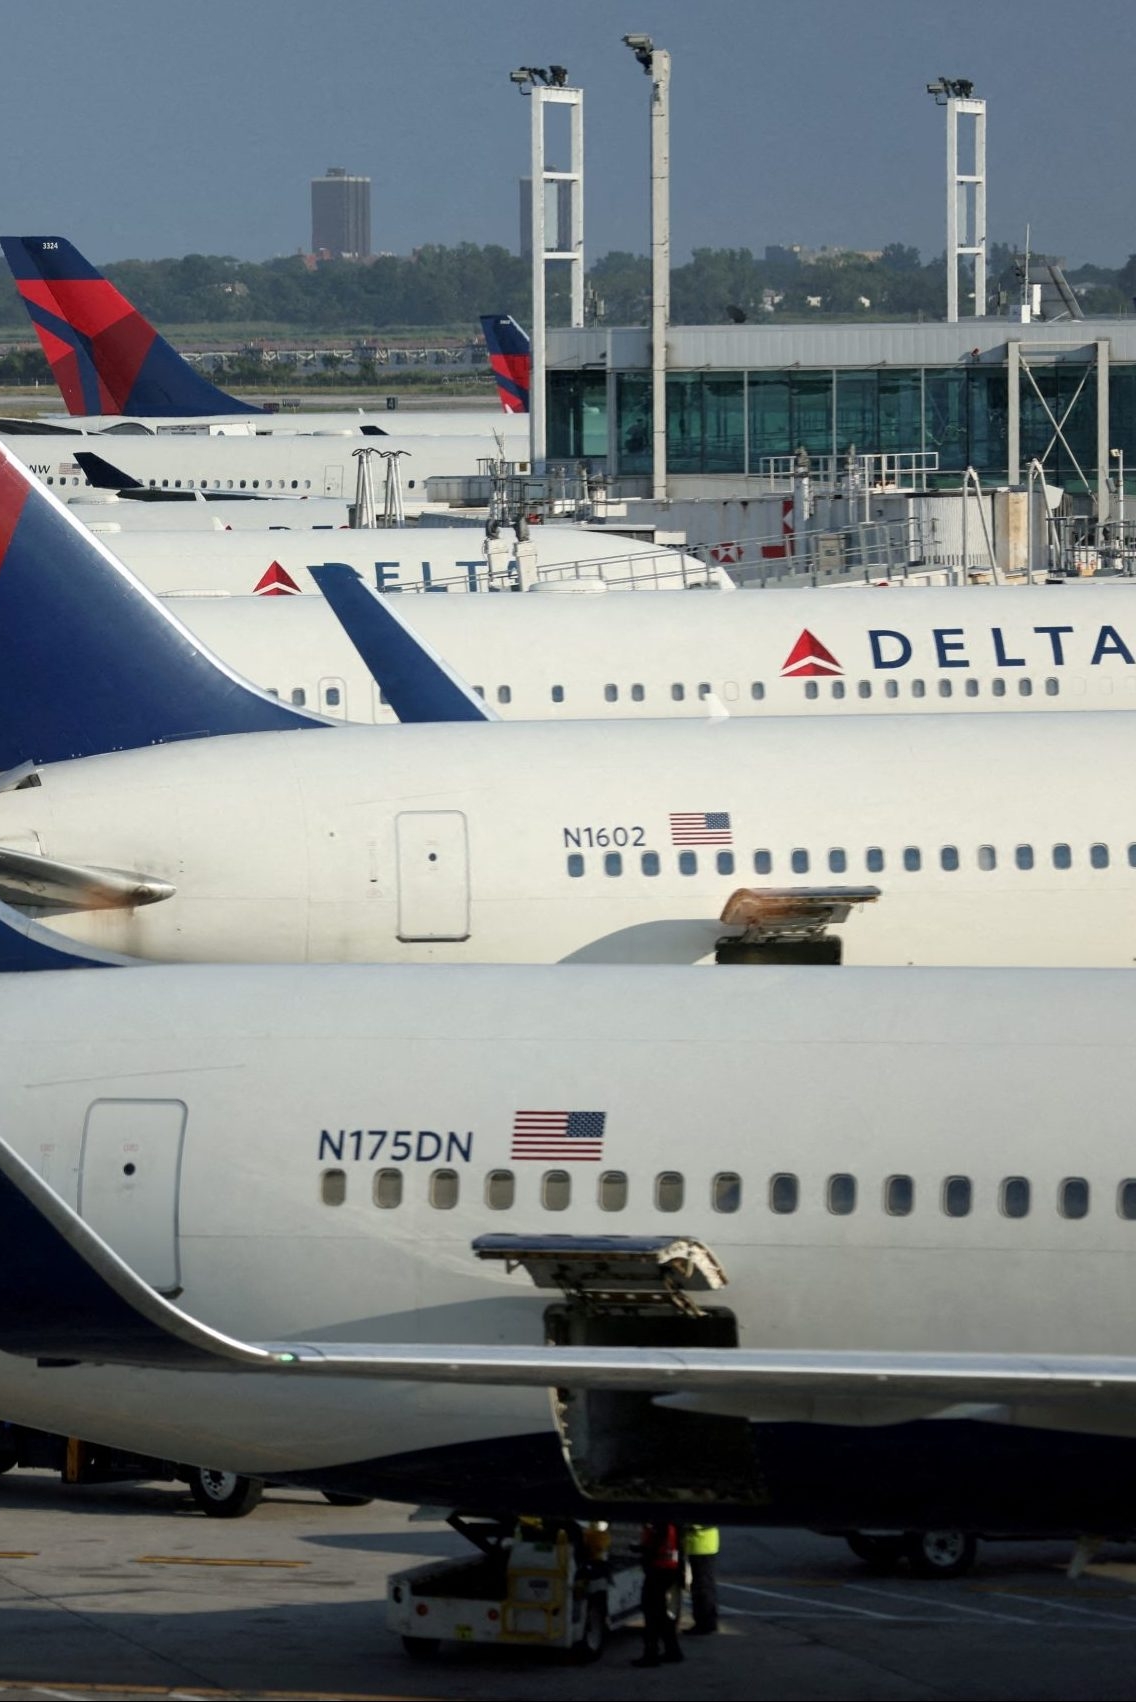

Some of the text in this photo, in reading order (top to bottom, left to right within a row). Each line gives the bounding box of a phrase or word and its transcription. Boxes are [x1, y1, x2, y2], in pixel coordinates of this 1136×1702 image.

[27, 464, 51, 474] NW
[324, 560, 519, 593] ELT
[867, 624, 1136, 670] DELTA
[563, 825, 647, 848] N1602
[318, 1129, 474, 1163] N175DN
